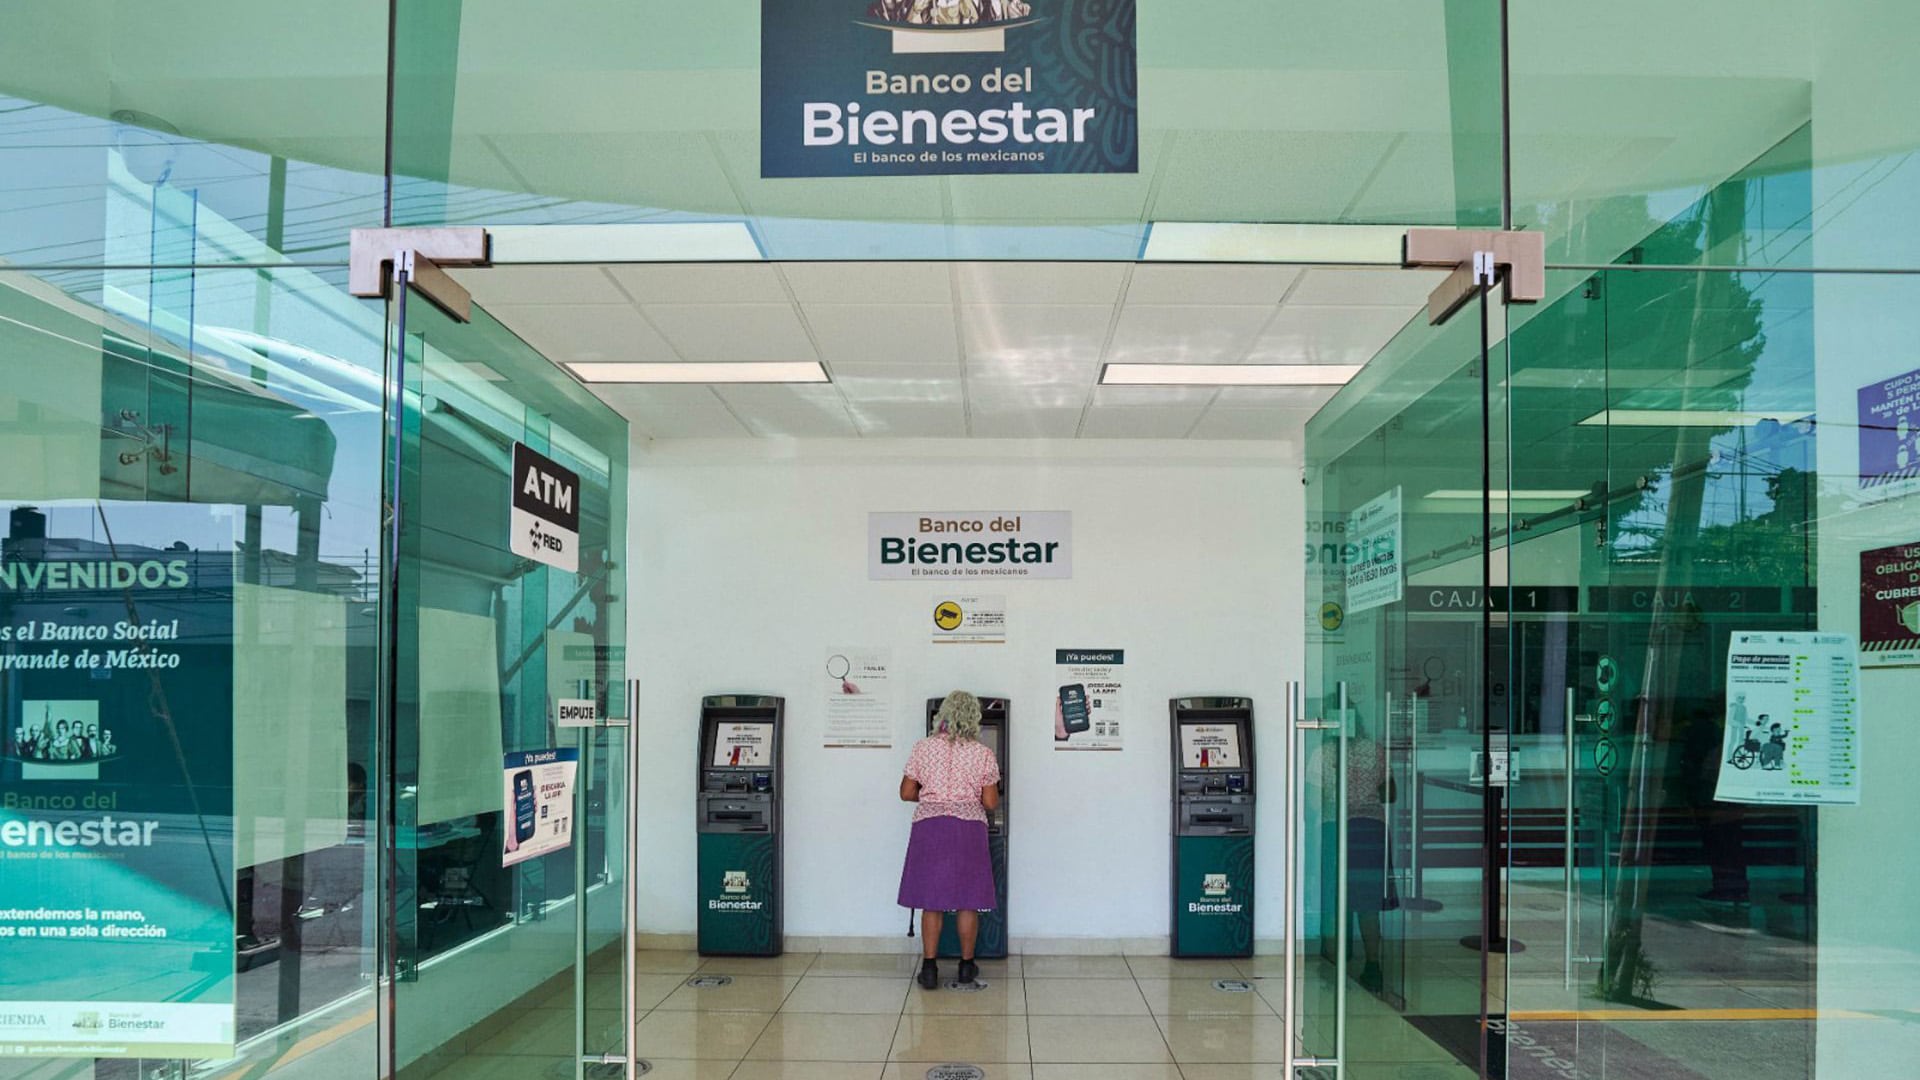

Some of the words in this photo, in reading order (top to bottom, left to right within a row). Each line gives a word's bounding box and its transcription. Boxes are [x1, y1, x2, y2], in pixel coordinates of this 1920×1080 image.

[866, 70, 971, 94] Banco
[981, 67, 1032, 93] del
[803, 101, 1095, 146] Bienestar
[853, 152, 867, 163] El
[871, 152, 915, 163] banco
[919, 151, 938, 162] de
[942, 151, 963, 162] los
[967, 150, 1045, 162] mexicanos
[523, 466, 572, 514] ATM
[919, 517, 983, 533] Banco
[989, 516, 1021, 532] del
[543, 533, 562, 552] RED
[881, 537, 1059, 564] Bienestar
[911, 568, 920, 576] El
[981, 567, 1028, 575] mexicanos
[1428, 590, 1495, 608] CAJA
[1527, 590, 1537, 608] 1
[1632, 591, 1696, 608] CAJA
[1729, 590, 1742, 608] 2
[1875, 586, 1920, 600] CUBRE
[16, 621, 34, 640] el
[41, 621, 107, 640] Banco
[113, 619, 178, 640] Social
[74, 650, 99, 669] de
[104, 648, 180, 669] México
[560, 706, 594, 720] EMPUJE
[4, 791, 75, 809] Banco
[83, 791, 117, 809] del
[1, 816, 159, 846] enestar
[708, 900, 762, 910] Bienestar
[1188, 903, 1242, 912] Bienestar
[85, 908, 98, 921] la
[101, 910, 146, 923] mano,
[19, 927, 37, 938] en
[40, 927, 67, 938] una
[70, 925, 99, 938] sola
[102, 924, 166, 938] dirección
[109, 1018, 165, 1029] Bienestar
